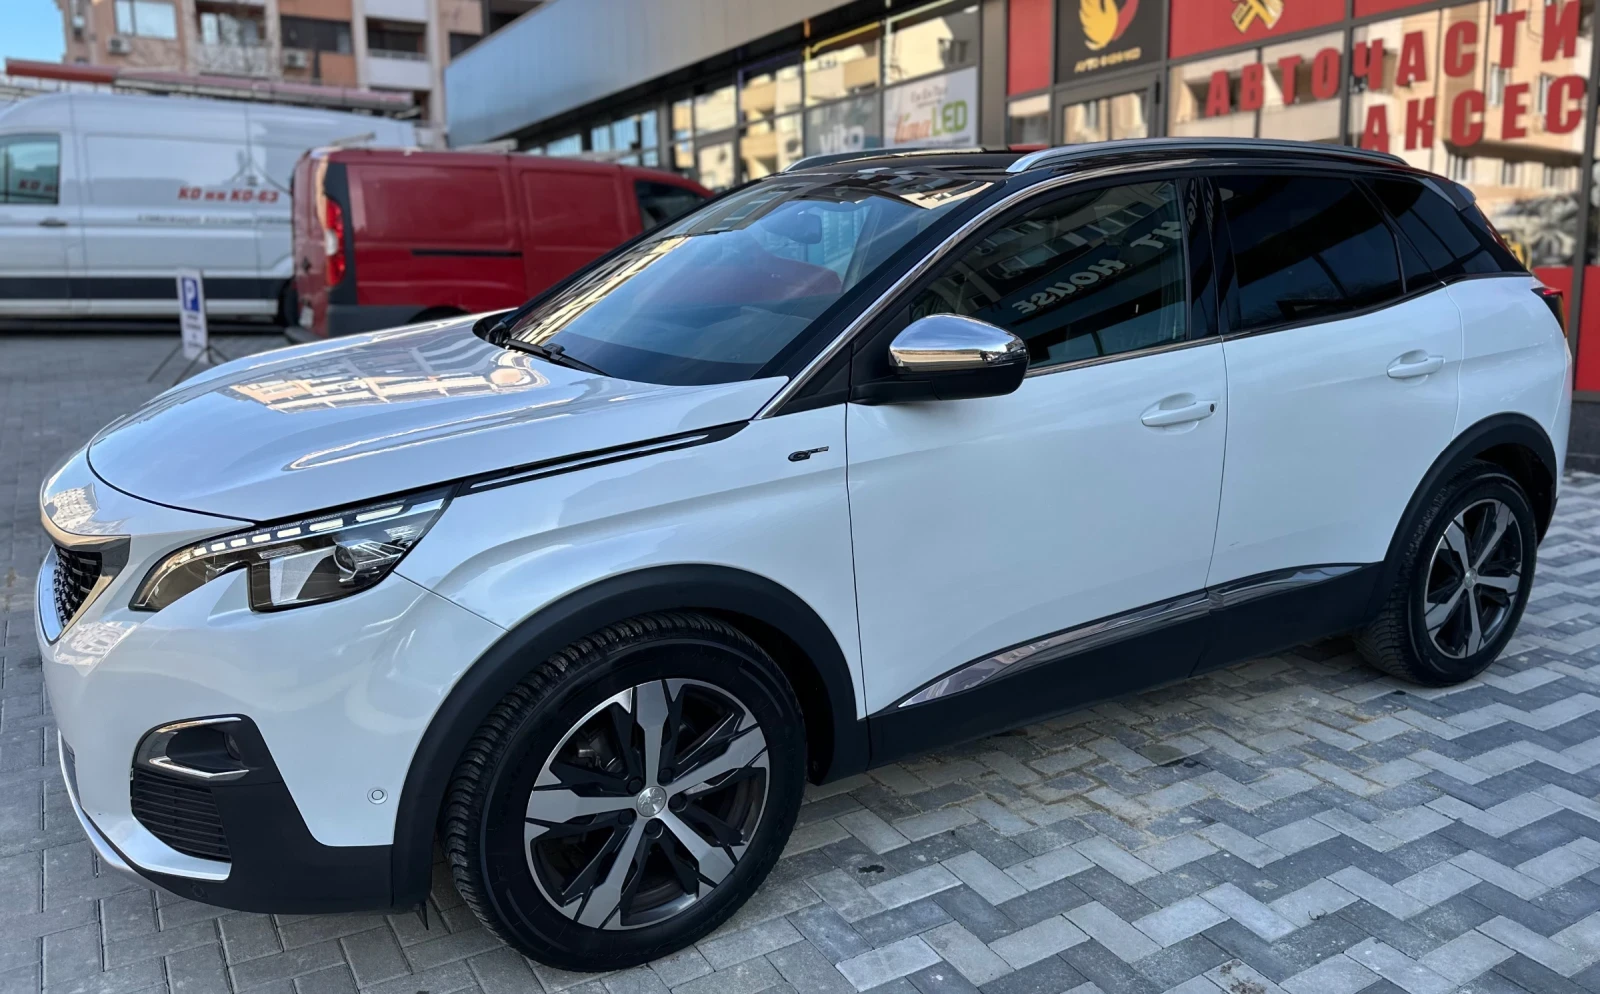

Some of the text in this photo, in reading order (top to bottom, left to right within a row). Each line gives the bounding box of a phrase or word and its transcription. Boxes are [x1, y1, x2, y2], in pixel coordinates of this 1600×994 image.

[1205, 0, 1580, 118] АВТОЧАСТИ
[1361, 75, 1586, 154] АКСЕС
[184, 280, 197, 312] P
